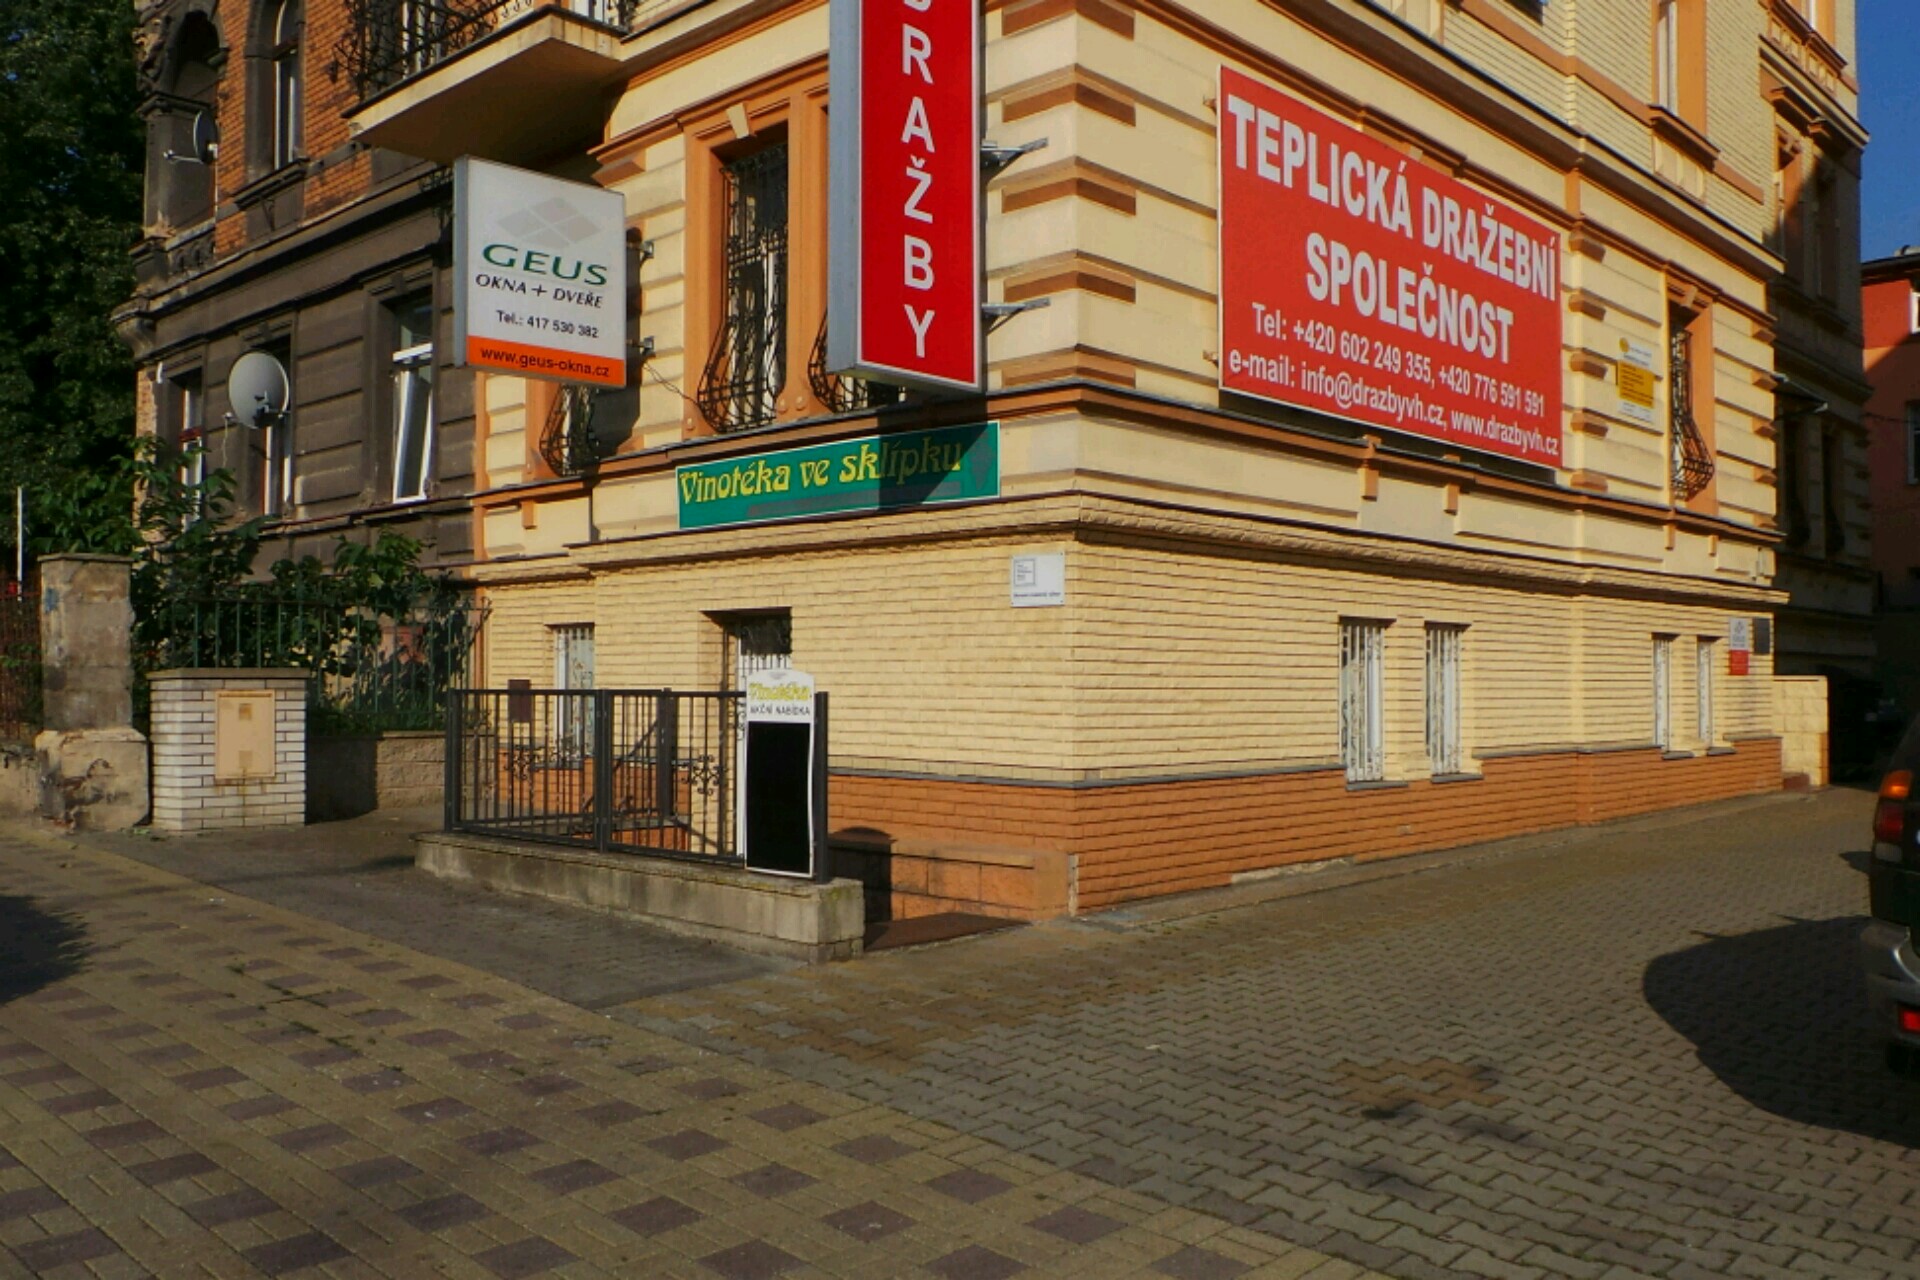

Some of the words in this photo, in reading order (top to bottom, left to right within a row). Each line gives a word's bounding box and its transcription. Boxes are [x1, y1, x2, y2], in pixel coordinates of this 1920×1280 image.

[901, 0, 935, 359] RAŽBY
[1228, 94, 1413, 239] TEPLICKÁ
[1422, 186, 1557, 301] DRAŽEBNÍ
[475, 273, 527, 294] OKNA
[553, 287, 604, 309] DVEŘE
[482, 243, 608, 286] GEUS
[1306, 232, 1514, 364] SPOLEČNOST
[480, 348, 610, 378] www.geus-okna.cz
[496, 309, 524, 326] Tel.:
[526, 316, 550, 330] 417
[552, 320, 575, 335] 530
[578, 325, 600, 339] 382
[1252, 302, 1287, 341] Tel:
[1293, 320, 1336, 355] +420
[1340, 330, 1370, 366] 602
[1374, 341, 1401, 375] 249
[1405, 350, 1436, 389] 355,
[1438, 364, 1471, 396] +420
[1474, 372, 1499, 404] 776
[1501, 381, 1522, 411] 591
[1524, 390, 1545, 418] 591
[1229, 349, 1296, 388] e-mail:
[1301, 360, 1448, 432] info@drazbyvh.cz,
[1451, 410, 1560, 456] www.drazbyvh.cz
[679, 460, 790, 505] Vinotéka
[799, 459, 830, 488] ve
[838, 436, 963, 486] sklípku
